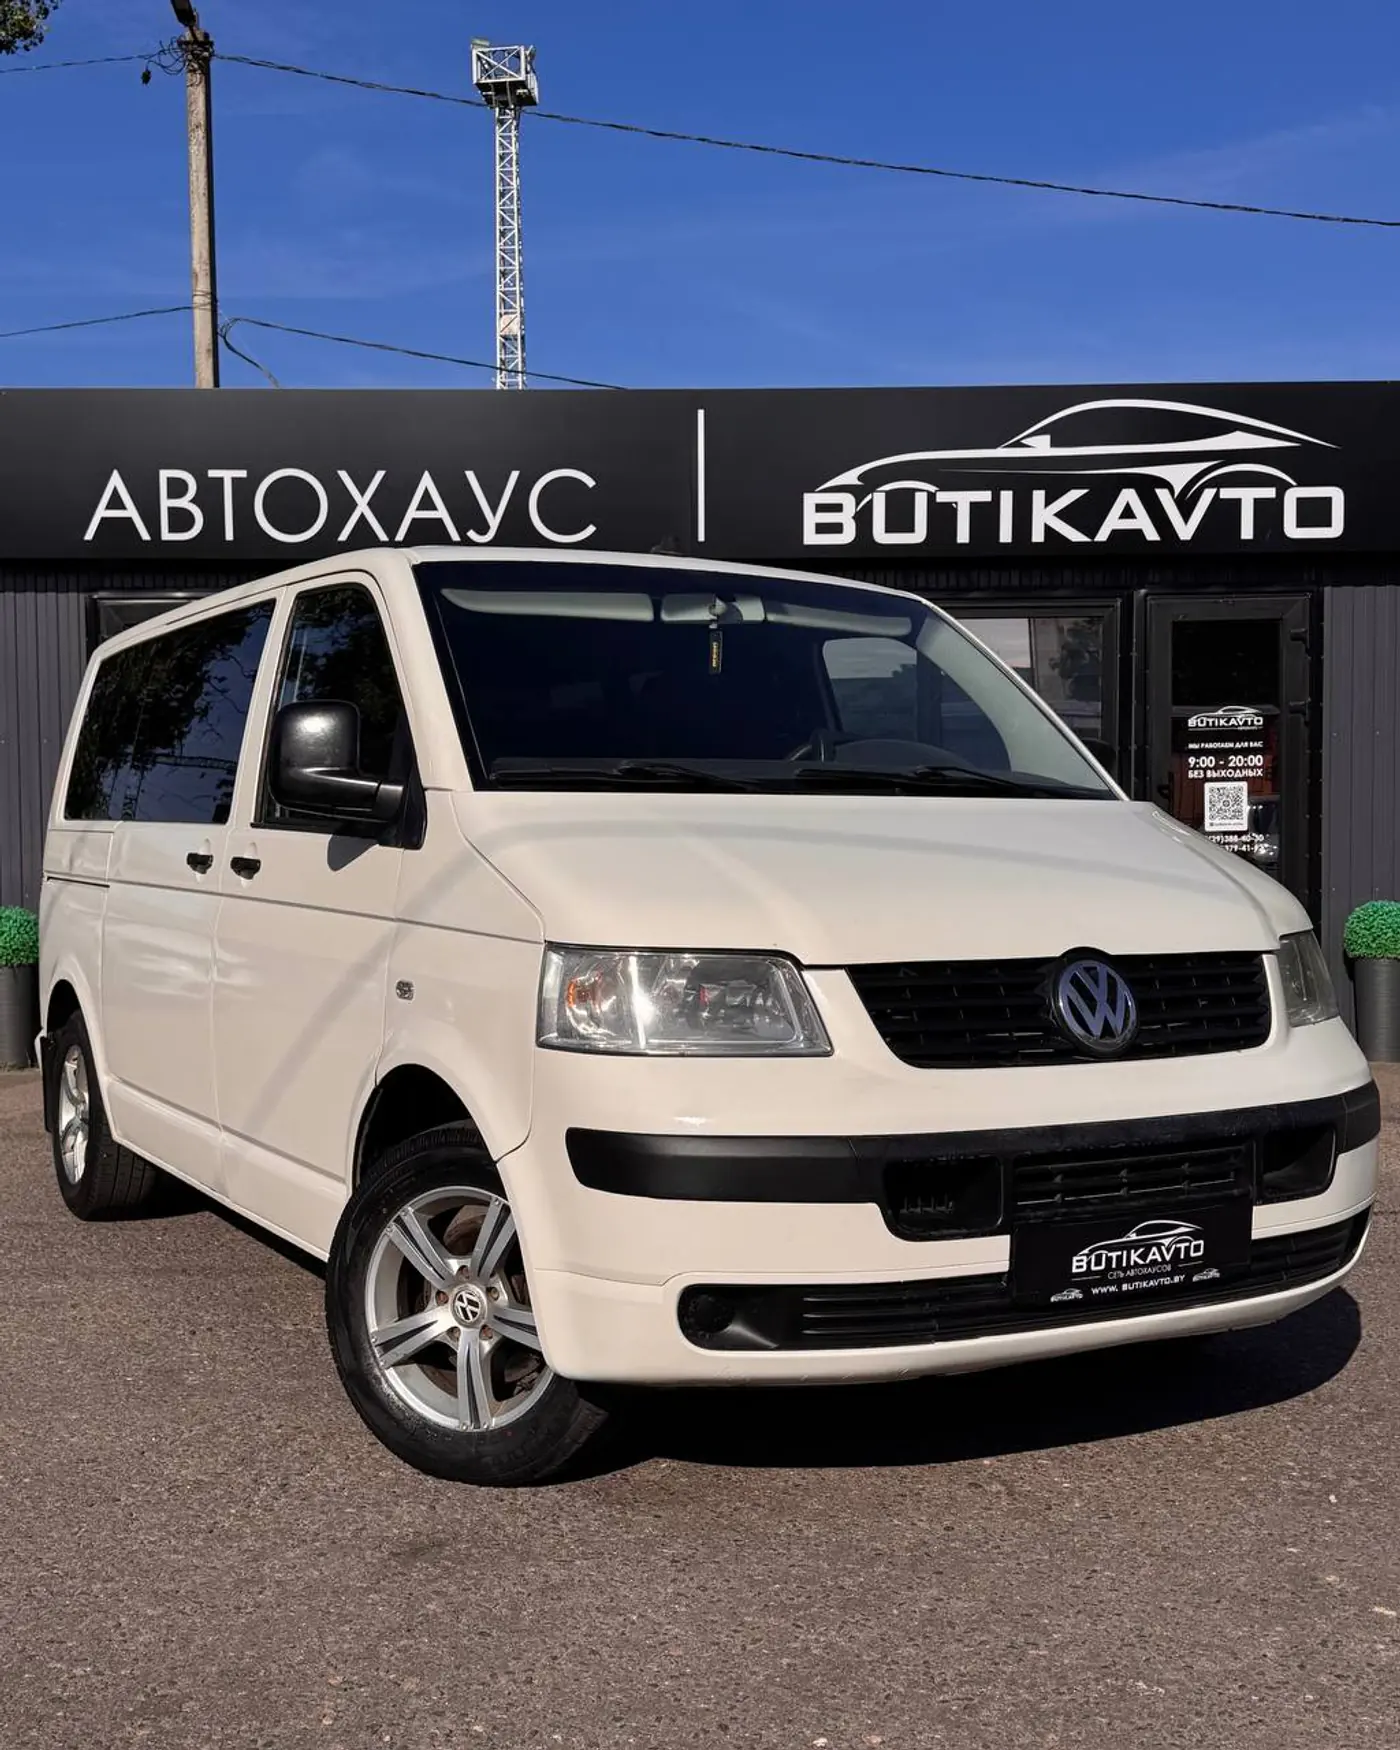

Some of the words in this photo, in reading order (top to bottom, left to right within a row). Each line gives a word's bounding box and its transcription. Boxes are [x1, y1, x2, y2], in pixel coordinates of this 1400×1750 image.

[83, 467, 597, 544] АВТОХАУС
[803, 485, 1345, 546] BUTIKAVTO
[1187, 717, 1264, 727] BUTIKAVTO
[1188, 755, 1216, 768] 9:00
[1228, 754, 1264, 767] 20:00
[1188, 769, 1205, 779] БЕЗ
[1206, 768, 1263, 778] ВЫХОДНЫХ
[1071, 1239, 1205, 1273] BUTIKAVTO
[1107, 1271, 1125, 1280] СЕТЬ
[1121, 1274, 1186, 1291] BUTIKAVTO.BY
